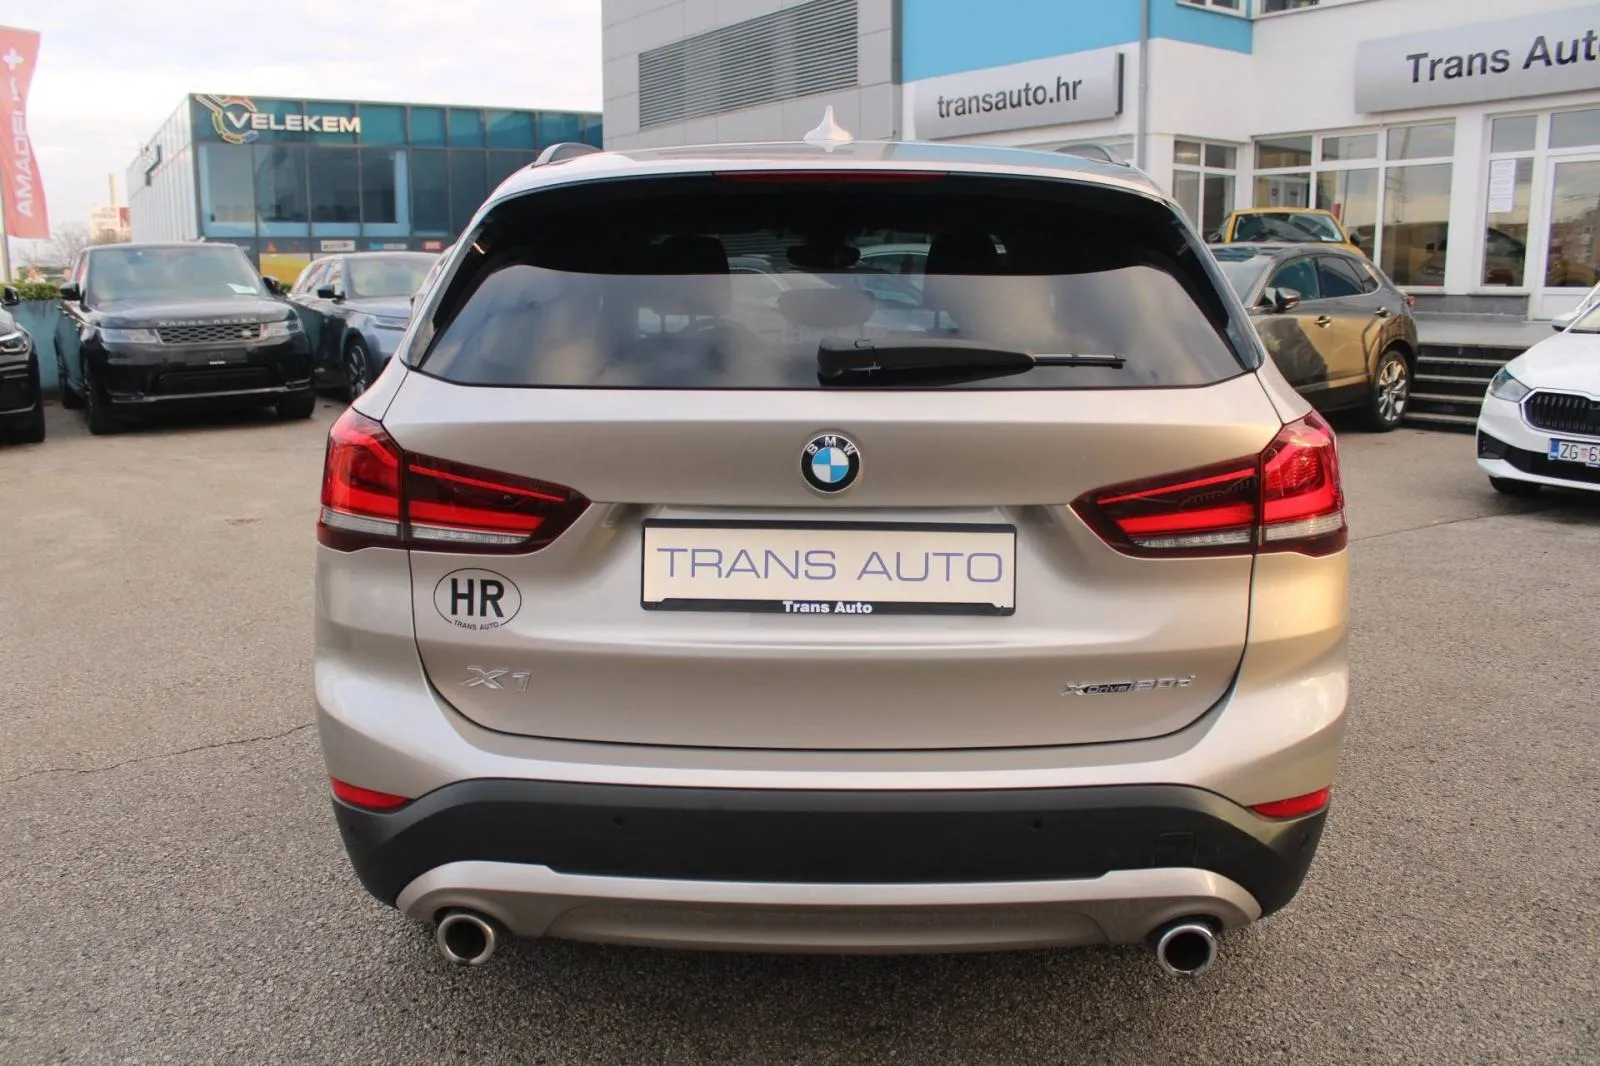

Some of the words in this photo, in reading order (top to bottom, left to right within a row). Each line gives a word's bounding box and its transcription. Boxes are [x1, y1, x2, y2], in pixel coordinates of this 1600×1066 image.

[1406, 49, 1510, 83] Trans
[1522, 30, 1600, 69] Aut
[937, 76, 1082, 118] transauto.hr
[225, 112, 361, 133] VELEKEM
[807, 436, 857, 456] BMW
[1560, 443, 1578, 460] ZG
[1589, 446, 1600, 462] 6
[657, 548, 837, 580] TRANS
[857, 551, 1003, 583] AUTO
[451, 578, 504, 617] HR
[783, 601, 830, 613] Trans
[834, 601, 873, 614] Auto
[454, 620, 477, 631] TRANS
[480, 621, 499, 630] AUTO
[459, 666, 531, 691] X1
